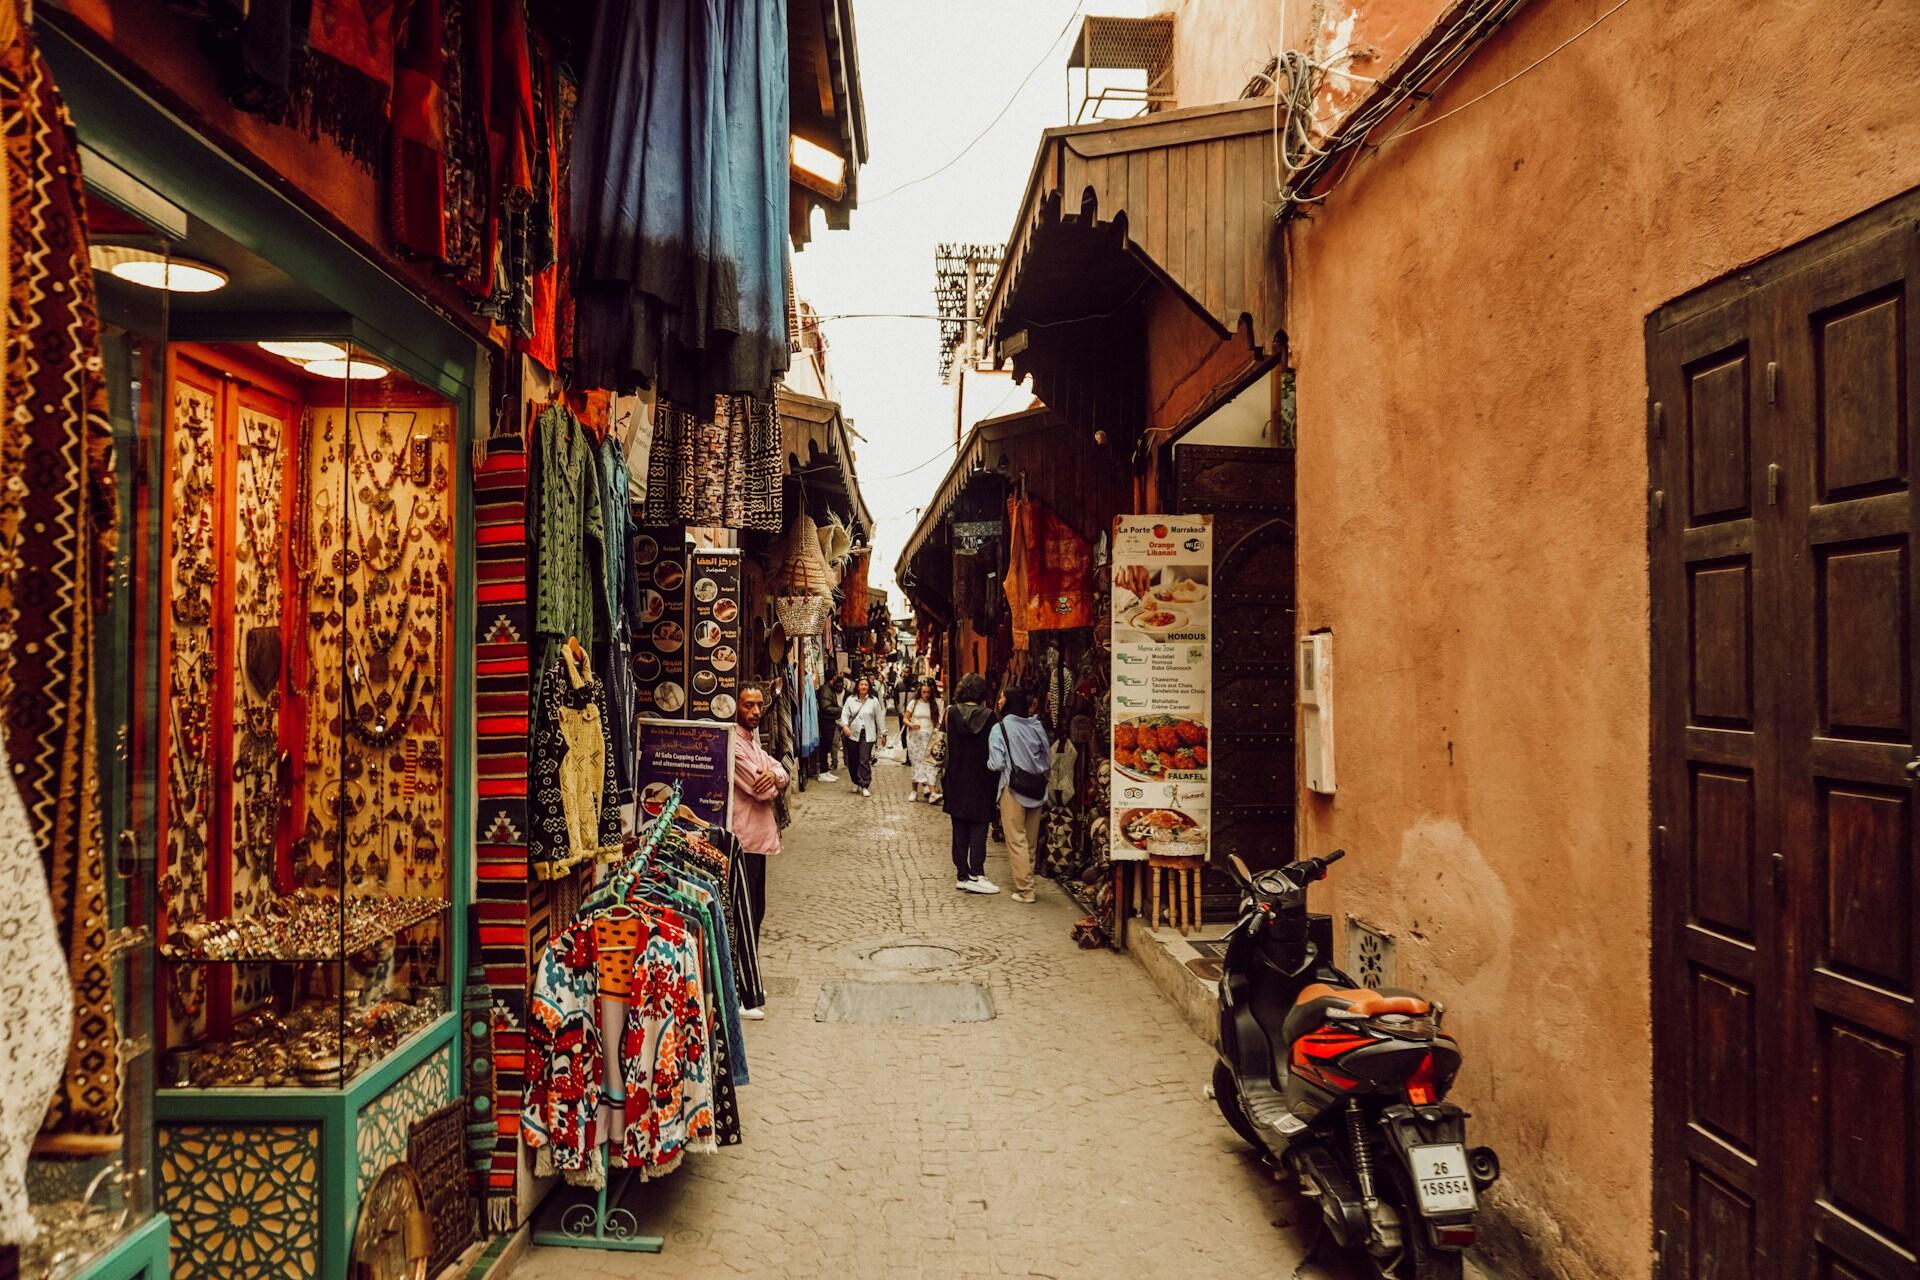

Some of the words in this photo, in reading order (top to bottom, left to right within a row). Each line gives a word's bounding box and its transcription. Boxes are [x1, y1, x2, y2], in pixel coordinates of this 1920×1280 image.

[1148, 542, 1175, 550] Orange
[672, 753, 694, 762] Cupping
[1433, 1162, 1448, 1175] 26
[1422, 1180, 1469, 1196] 158554
